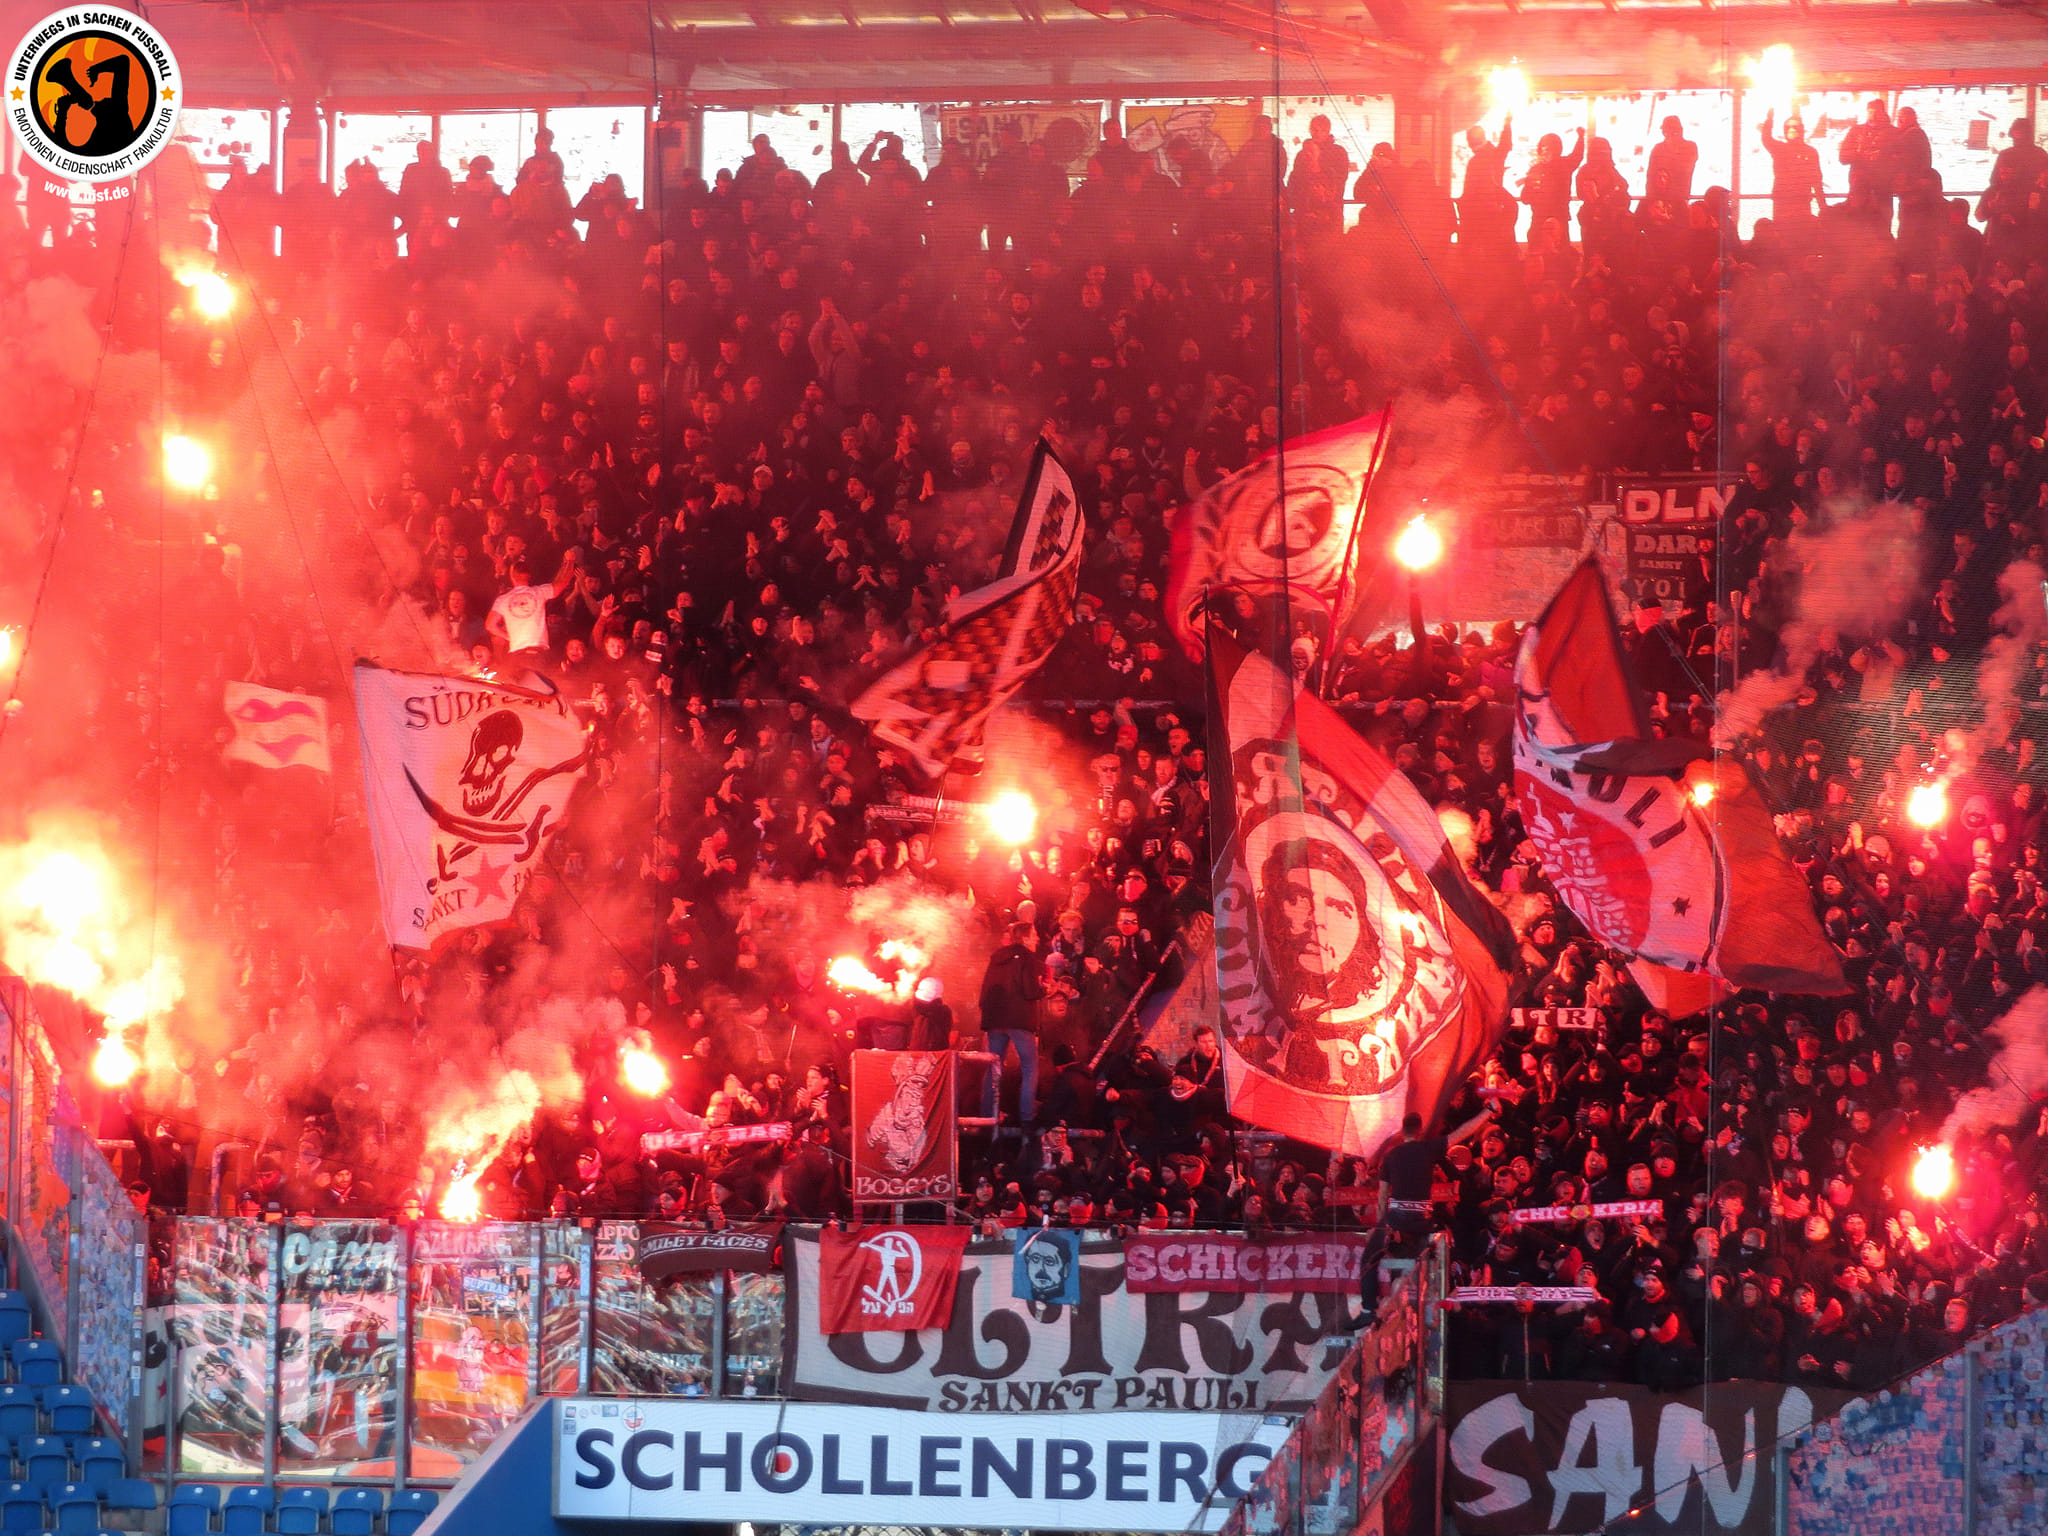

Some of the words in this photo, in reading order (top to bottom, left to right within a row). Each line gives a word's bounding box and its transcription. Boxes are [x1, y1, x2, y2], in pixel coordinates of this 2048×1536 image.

[1514, 1206, 1567, 1222] CHIC
[1593, 1200, 1661, 1217] KERIA
[701, 1235, 769, 1249] FACES
[938, 1378, 1100, 1413] SANKT
[1113, 1376, 1259, 1411] PAULI
[574, 1428, 1273, 1503] SCHOLLENBERG
[1450, 1386, 1814, 1531] SAN
